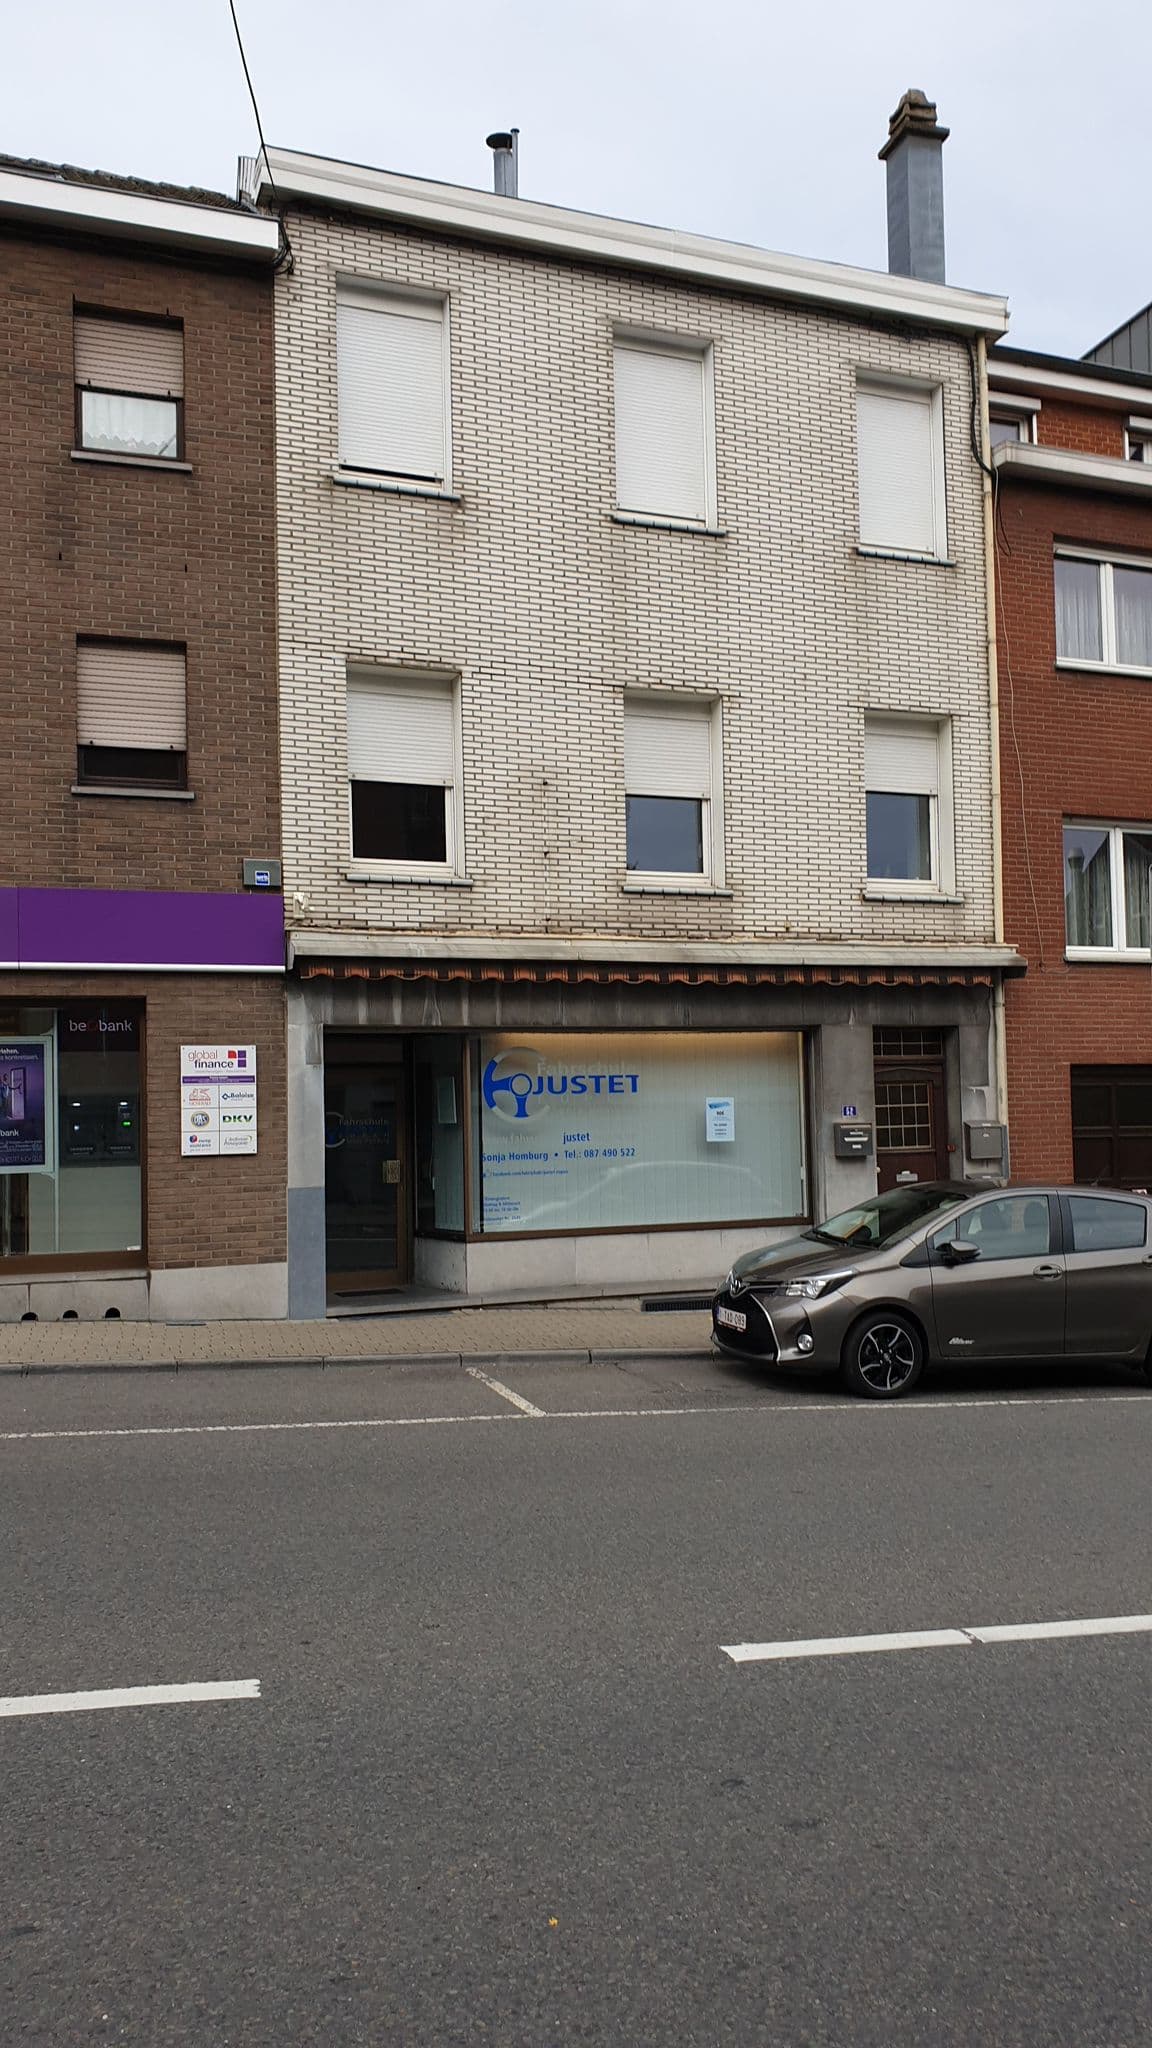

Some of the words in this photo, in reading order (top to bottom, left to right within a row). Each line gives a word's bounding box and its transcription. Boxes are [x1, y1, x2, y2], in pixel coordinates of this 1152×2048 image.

[188, 1050, 218, 1061] global
[194, 1059, 234, 1069] finance
[533, 1074, 640, 1095] JUSTET
[222, 1114, 253, 1123] DKV
[482, 1152, 506, 1164] Sonja
[509, 1150, 549, 1162] Homburg
[584, 1149, 599, 1159] 087
[602, 1148, 618, 1158] 490
[620, 1147, 636, 1157] 522
